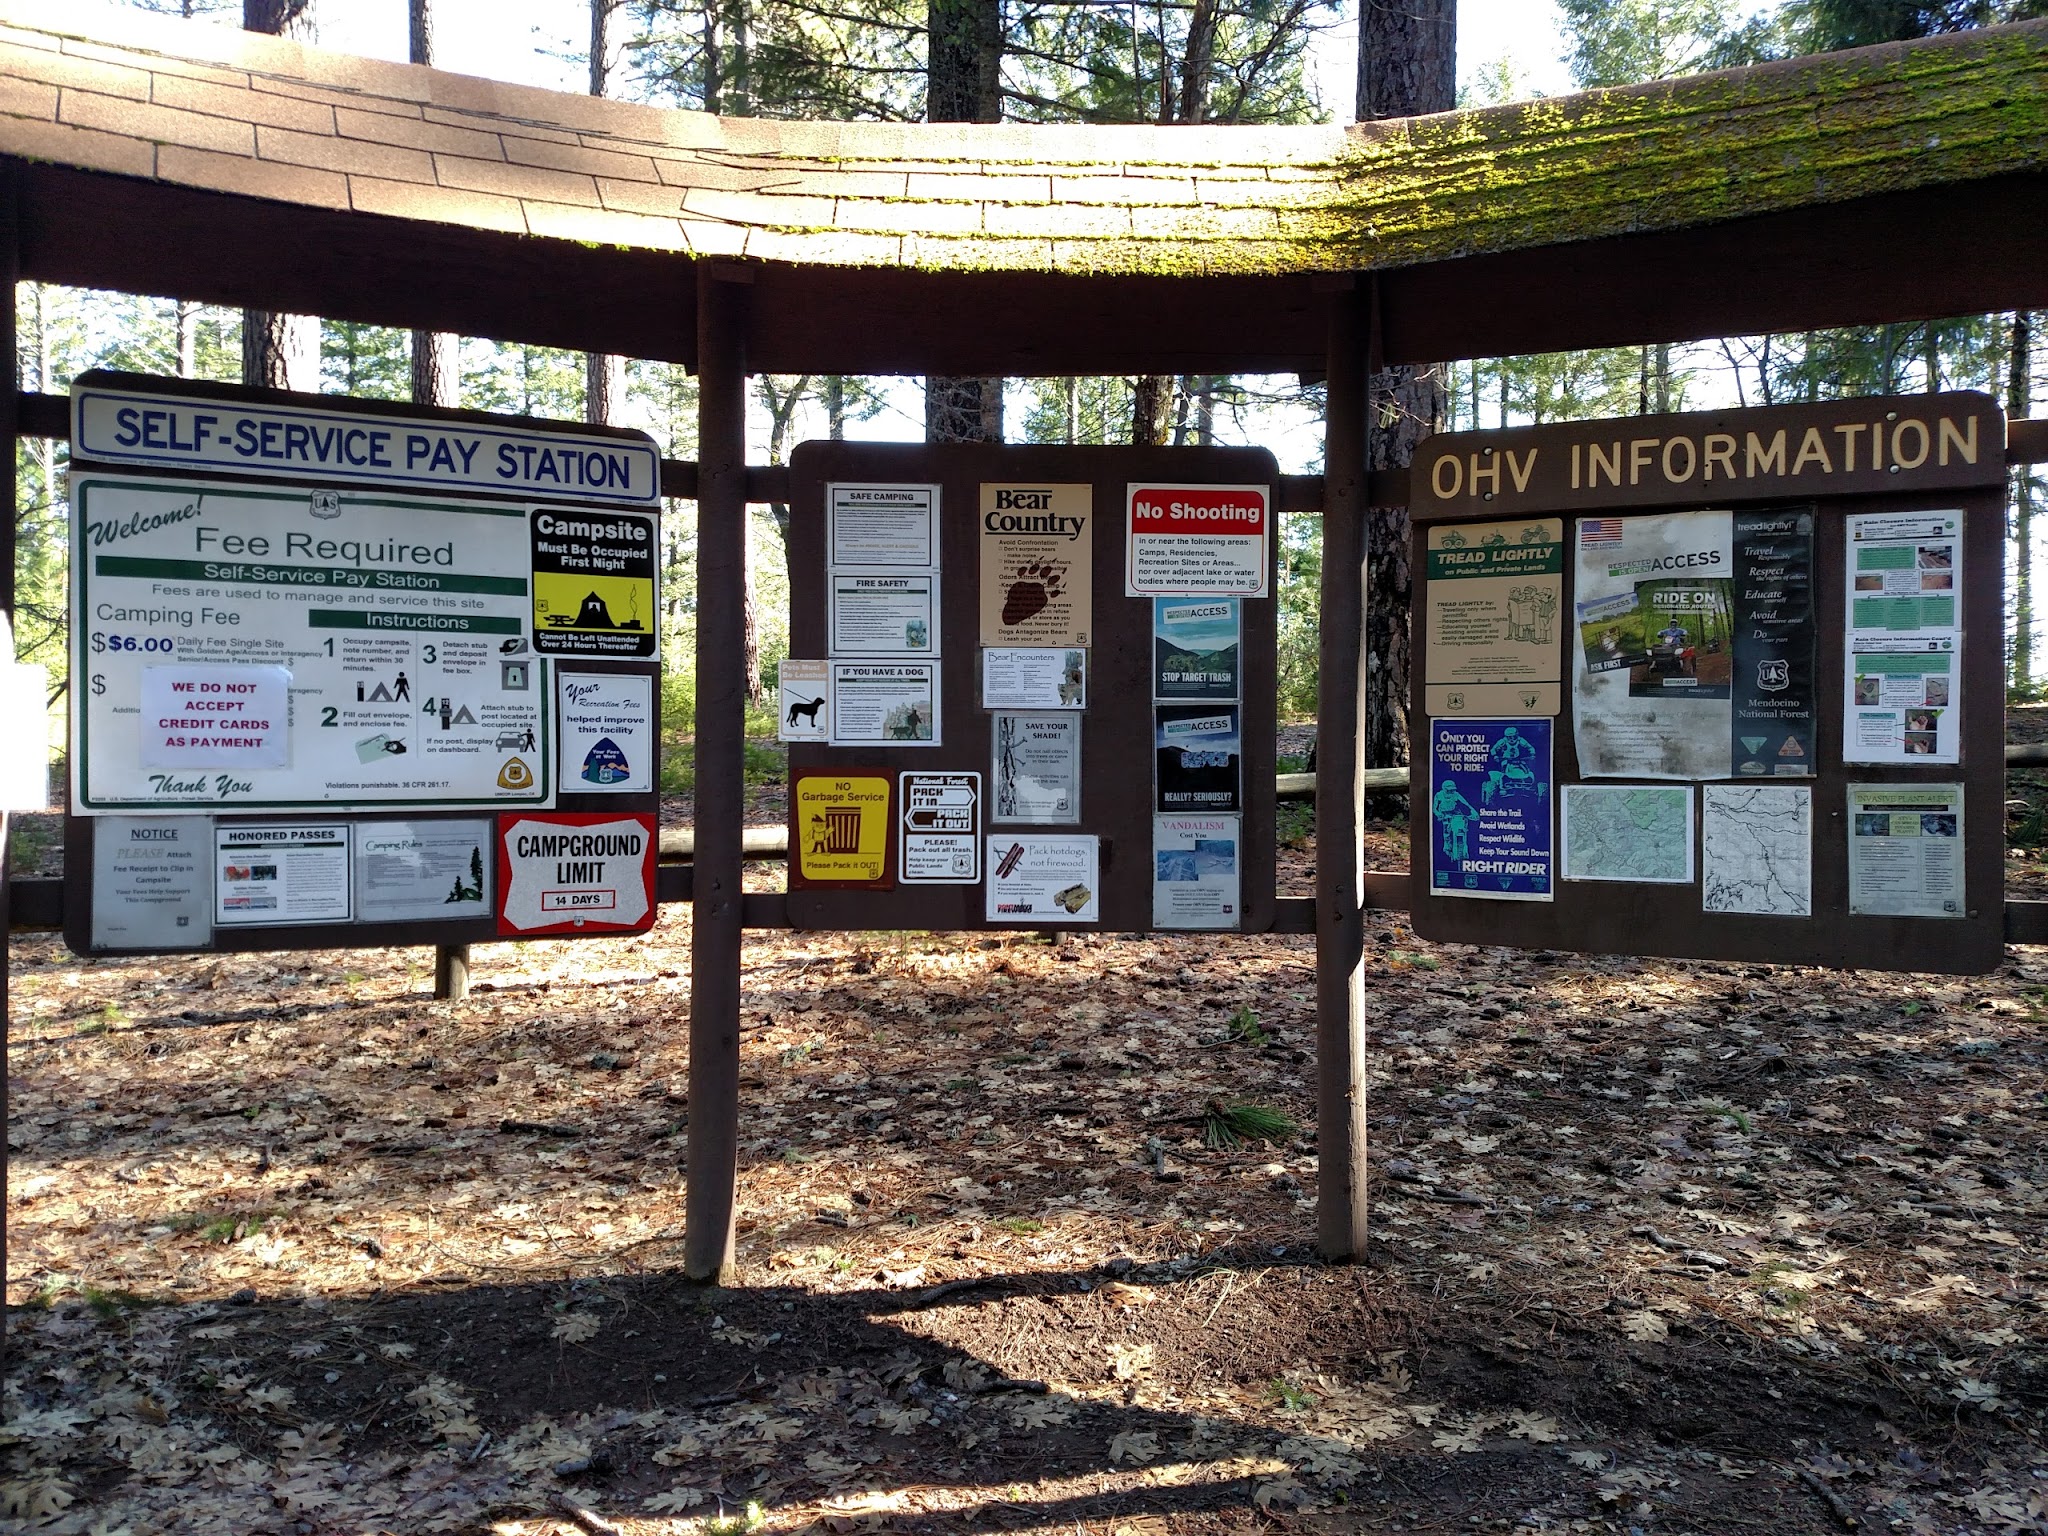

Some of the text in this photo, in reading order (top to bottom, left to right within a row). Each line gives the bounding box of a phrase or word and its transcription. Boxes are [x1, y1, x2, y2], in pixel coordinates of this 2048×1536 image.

[114, 408, 630, 489] SELF-SERVICE PAY STATION
[1432, 415, 1978, 499] OHV INFORMATION
[850, 492, 914, 501] SAFE CAMPING
[995, 490, 1052, 509] Bear
[1136, 502, 1260, 523] No Shooting
[87, 495, 204, 546] Welcome!
[985, 511, 1086, 541] Country
[537, 515, 647, 541] Campsite
[196, 527, 453, 567] Fee Required
[1191, 538, 1226, 547] following
[537, 541, 648, 560] Must Be Occupied
[1437, 547, 1553, 565] TREAD LIGHTLY
[1744, 546, 1773, 556] Travel
[561, 555, 625, 571] First Night
[1608, 559, 1651, 569] RESPECTED
[1650, 550, 1722, 572] ACCESS
[1456, 567, 1479, 575] Public
[1480, 566, 1494, 574] and
[1496, 565, 1521, 573] Private
[1523, 564, 1546, 572] Lands
[1749, 567, 1785, 577] Respect
[204, 564, 440, 589] Self-Service Pay Station
[152, 584, 485, 609] Fees are used to manage and service this site
[1653, 592, 1716, 604] RIDE ON
[1744, 590, 1783, 600] Educate
[96, 603, 240, 627] Camping Fee
[1190, 606, 1228, 617] ACCESS
[1749, 610, 1777, 620] Avoid
[366, 612, 470, 630] Instructions
[1753, 629, 1767, 639] Do
[91, 631, 106, 653] $
[108, 634, 173, 654] $6.00
[177, 637, 285, 650] Daily Fee Single Site
[323, 637, 334, 657] 1
[422, 644, 437, 664] 3
[988, 651, 1056, 663] Bear Encounters
[905, 668, 924, 676] DOG
[1162, 672, 1232, 683] STOP TARGET TRASH
[91, 674, 107, 697] $
[171, 682, 257, 694] WE DO NOT
[565, 684, 600, 705] Your
[185, 701, 245, 712] ACCEPT
[422, 697, 436, 716] 4
[579, 698, 641, 710] Recreation Fees
[1748, 698, 1800, 708] Mendocino
[320, 706, 339, 727] 2
[1738, 709, 1778, 719] National
[1780, 709, 1810, 719] Forest
[159, 719, 270, 730] CREDIT CARDS
[567, 716, 645, 725] helped improve
[1025, 722, 1045, 730] SAVE
[1190, 720, 1228, 731] ACCESS
[578, 726, 634, 735] this facility
[1032, 732, 1061, 740] SHADE!
[1440, 730, 1485, 743] ONLY YOU
[165, 737, 263, 748] AS PAYMENT
[1435, 744, 1490, 753] CAN PROTECT
[1438, 753, 1488, 763] YOUR RIGHT
[1450, 763, 1485, 772] TO RIDE:
[148, 774, 253, 798] Thank You
[835, 782, 851, 791] NO
[802, 792, 885, 803] Garbage Service
[913, 788, 944, 797] PACK
[1164, 792, 1232, 802] REALLY? SERIOUSLY?
[913, 797, 938, 806] IT IN
[1857, 795, 1954, 803] INVASIVE PLANT ALERT
[936, 810, 969, 818] PACK
[932, 819, 969, 828] IT OUT
[1162, 821, 1225, 830] VANDALISM
[130, 829, 178, 841] NOTICE
[229, 831, 336, 841] HONORED PASSES
[365, 840, 401, 852] Camping
[402, 840, 423, 849] Rules
[517, 834, 641, 858] CAMPGROUND
[1029, 844, 1088, 857] Pack hotdogs,
[1030, 857, 1086, 867] not firewood.
[557, 861, 606, 884] LIMIT
[555, 895, 601, 905] 14 DAYS
